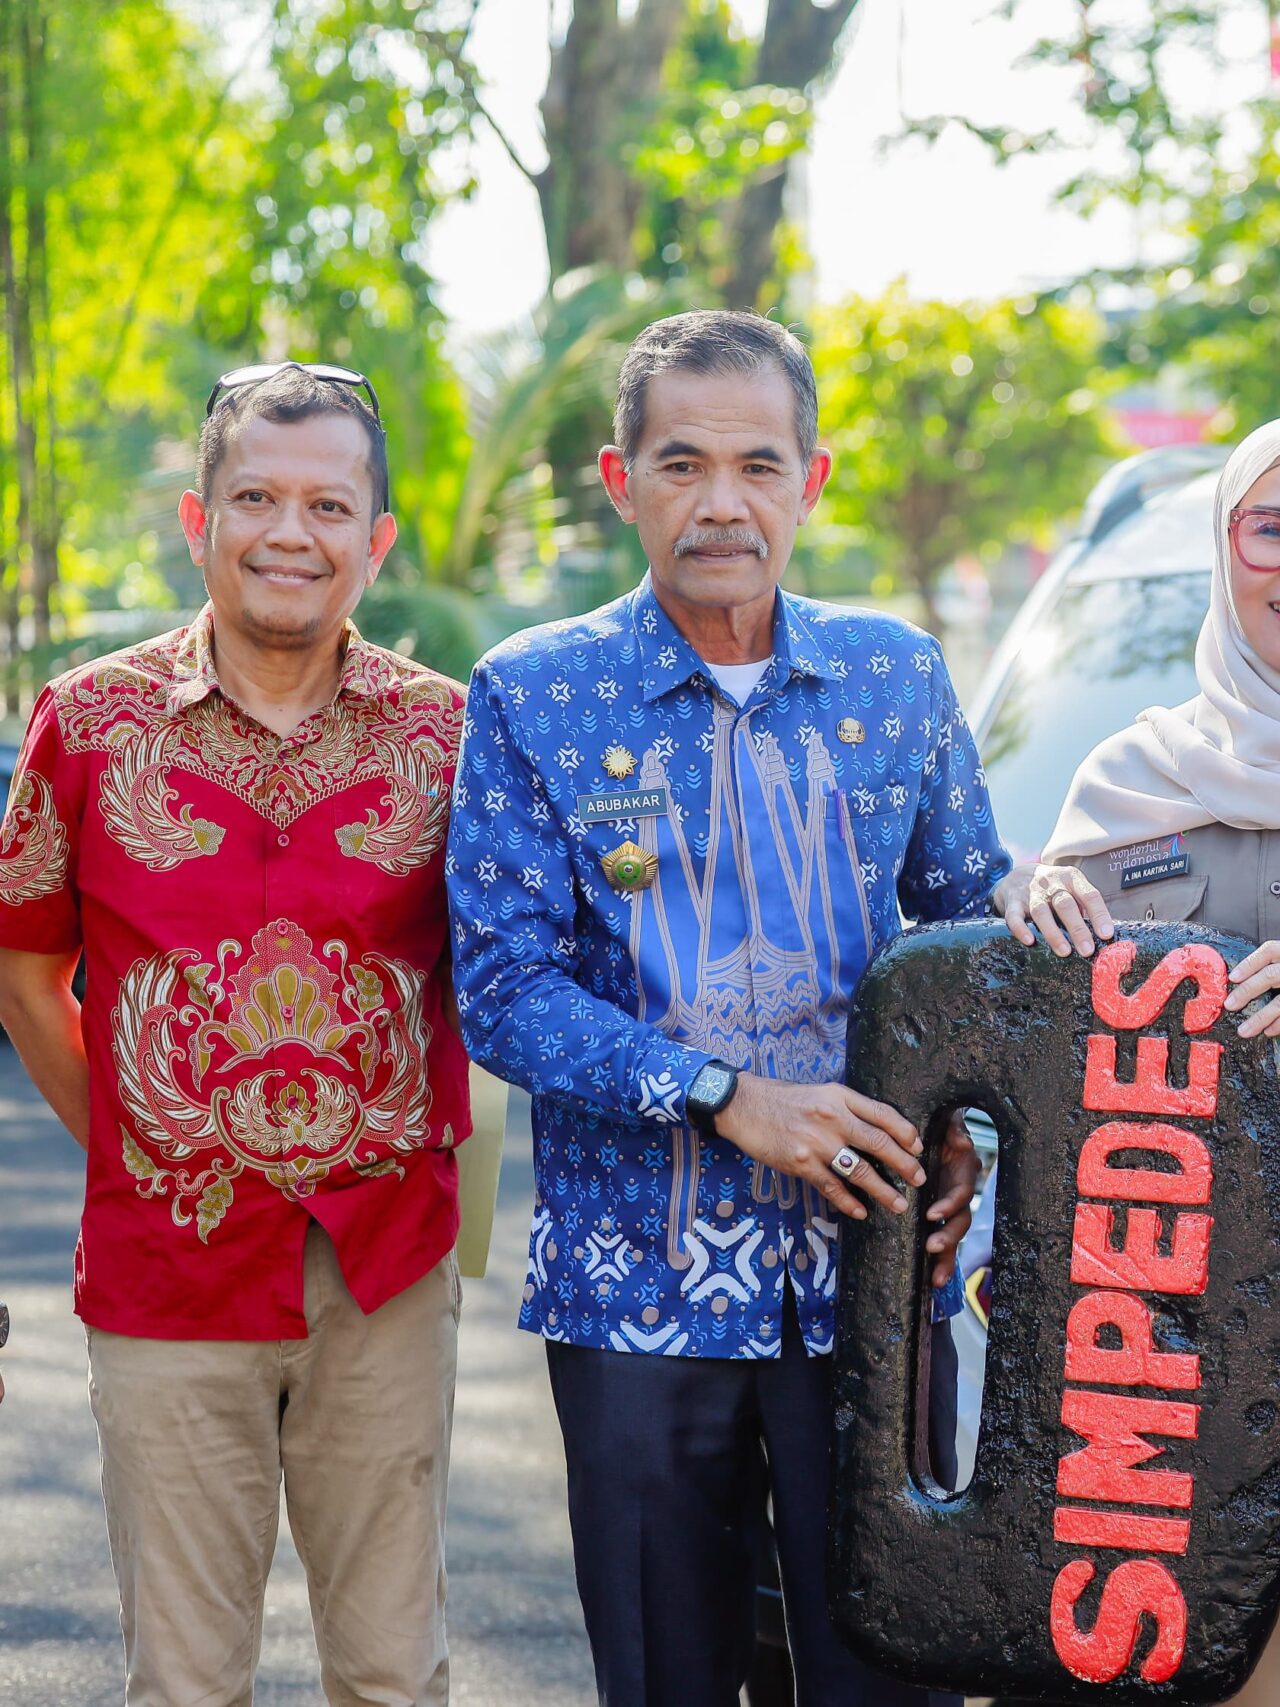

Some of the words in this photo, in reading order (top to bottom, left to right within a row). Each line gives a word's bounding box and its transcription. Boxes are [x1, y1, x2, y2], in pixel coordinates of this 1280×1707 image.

[587, 795, 660, 813] ABUBAKAR
[1108, 840, 1160, 860] wonderful
[1131, 871, 1142, 880] INA
[1143, 865, 1168, 877] KARTIKA
[1170, 860, 1185, 871] SARI
[1050, 939, 1230, 1684] SIMPEDES
